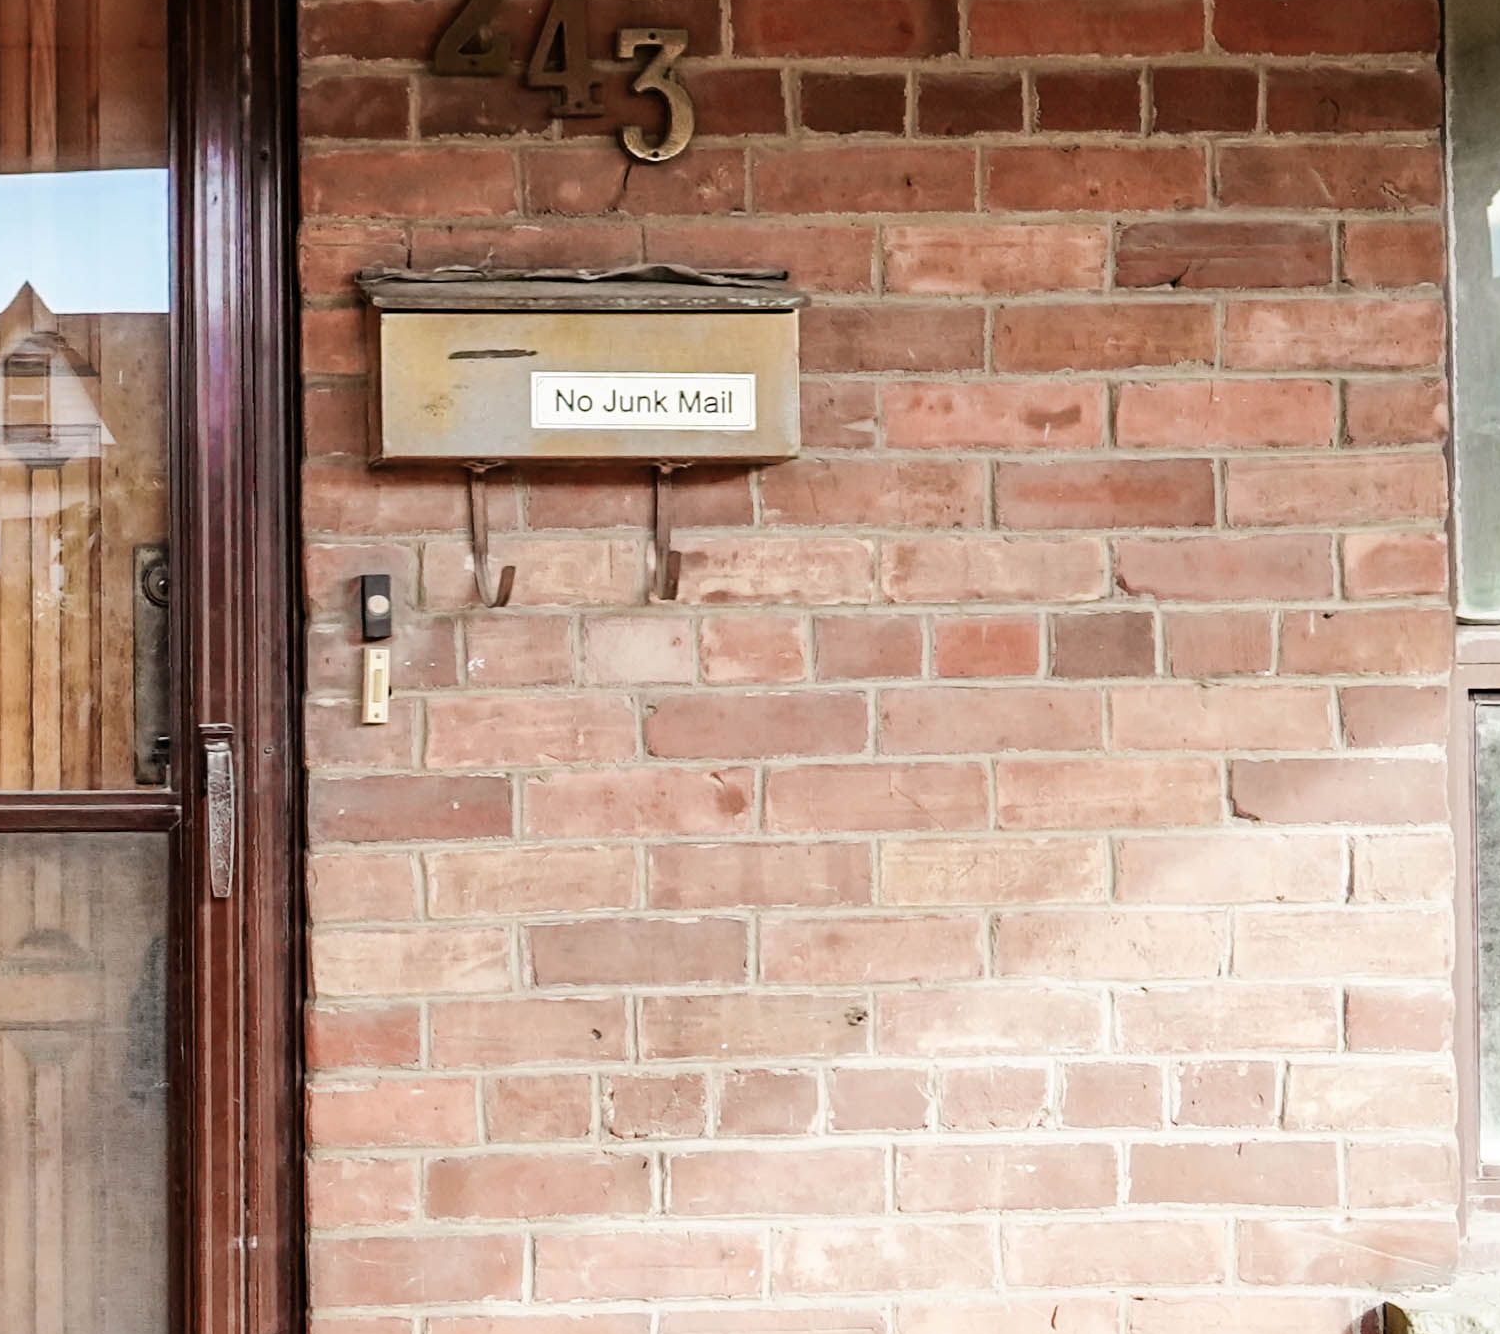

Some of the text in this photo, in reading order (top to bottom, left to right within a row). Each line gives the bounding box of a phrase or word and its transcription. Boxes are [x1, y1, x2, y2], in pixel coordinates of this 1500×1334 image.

[555, 388, 734, 414] No Junk Mail
